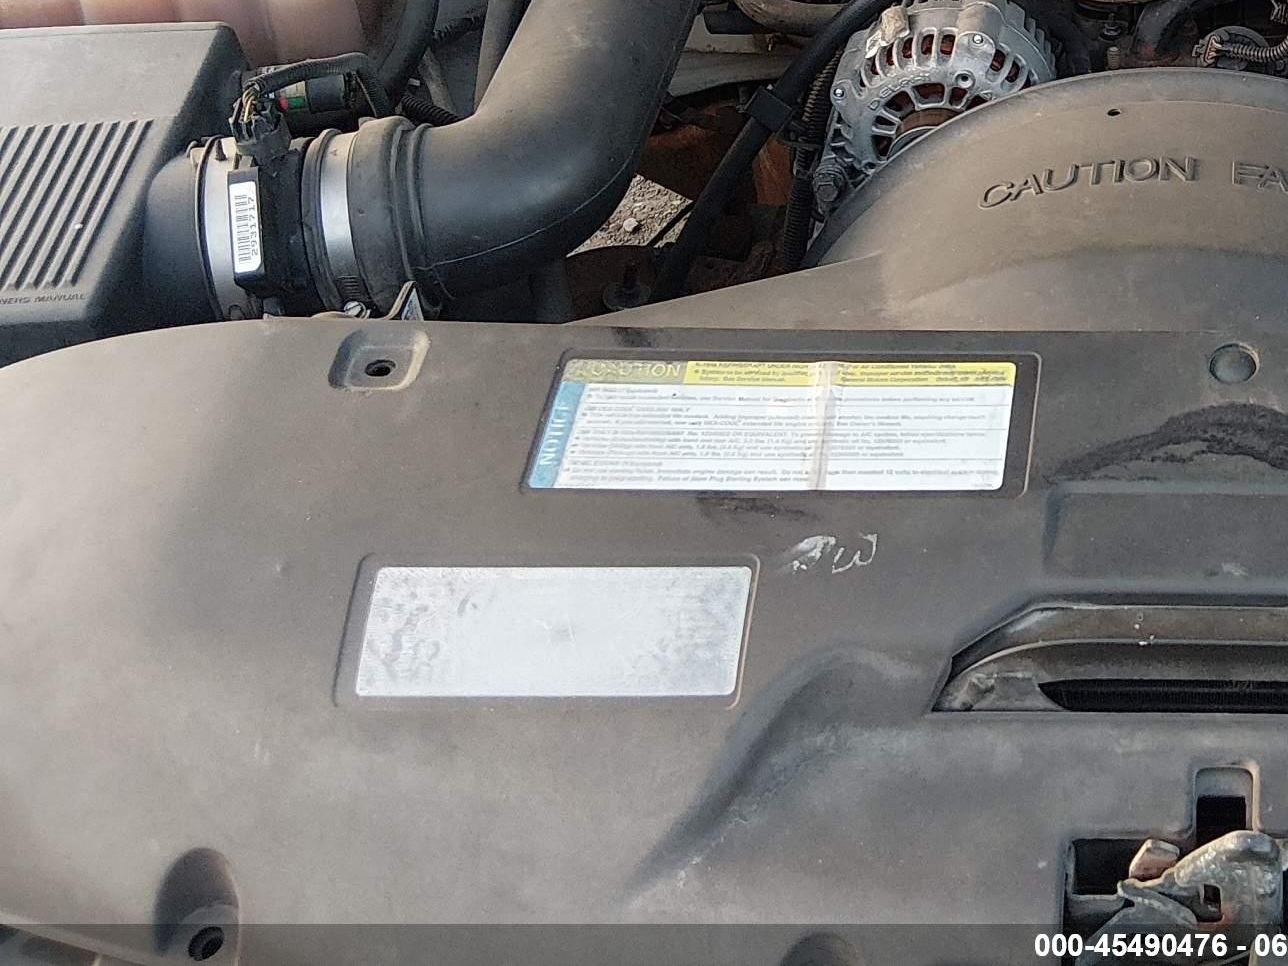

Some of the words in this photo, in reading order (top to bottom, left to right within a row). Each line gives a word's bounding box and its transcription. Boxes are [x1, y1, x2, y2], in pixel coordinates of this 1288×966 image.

[978, 155, 1199, 209] CAUTION
[248, 197, 258, 256] 2931717
[539, 401, 570, 466] NOTICE
